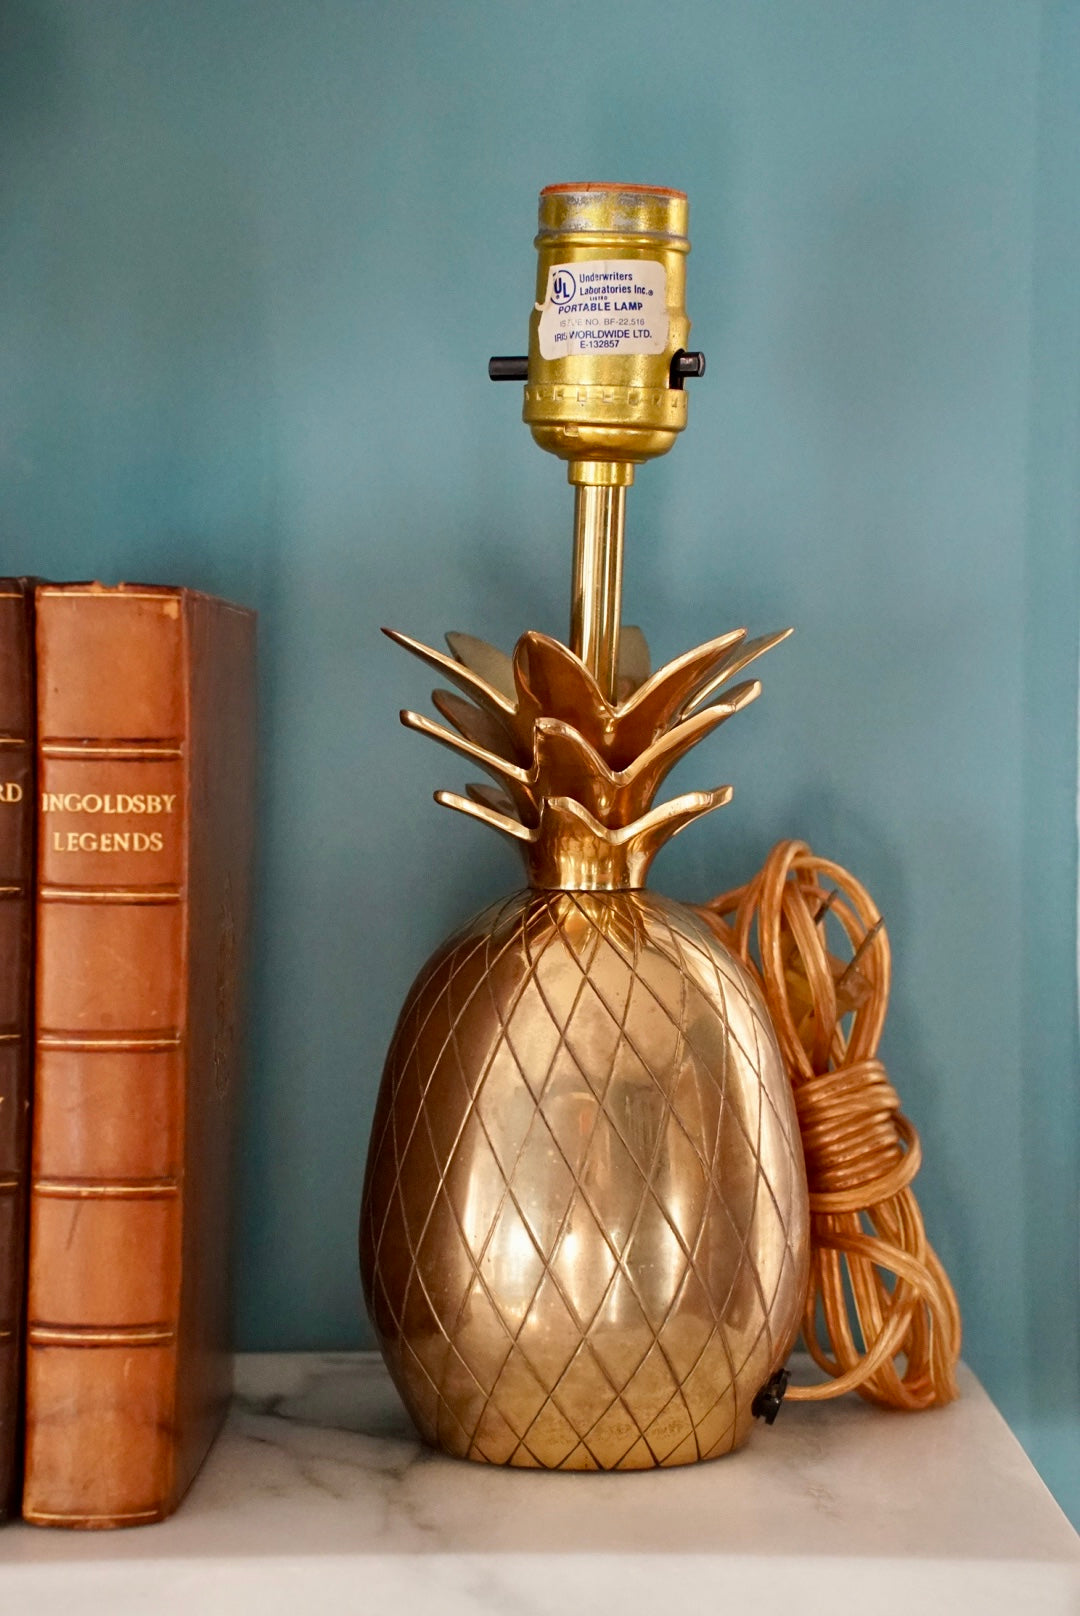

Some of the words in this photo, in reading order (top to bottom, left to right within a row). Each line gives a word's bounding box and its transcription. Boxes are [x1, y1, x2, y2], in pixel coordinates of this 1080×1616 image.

[579, 272, 633, 283] Underwriters
[554, 277, 570, 298] UL
[579, 285, 632, 296] Laboratories
[558, 302, 611, 314] PORTABLE
[614, 302, 643, 311] LAMP
[569, 329, 630, 339] WORLDWIDE
[633, 329, 653, 339] LTD.
[580, 340, 620, 349] E-132857
[42, 793, 176, 814] INGOLDSBY
[53, 832, 163, 852] LEGENDS
